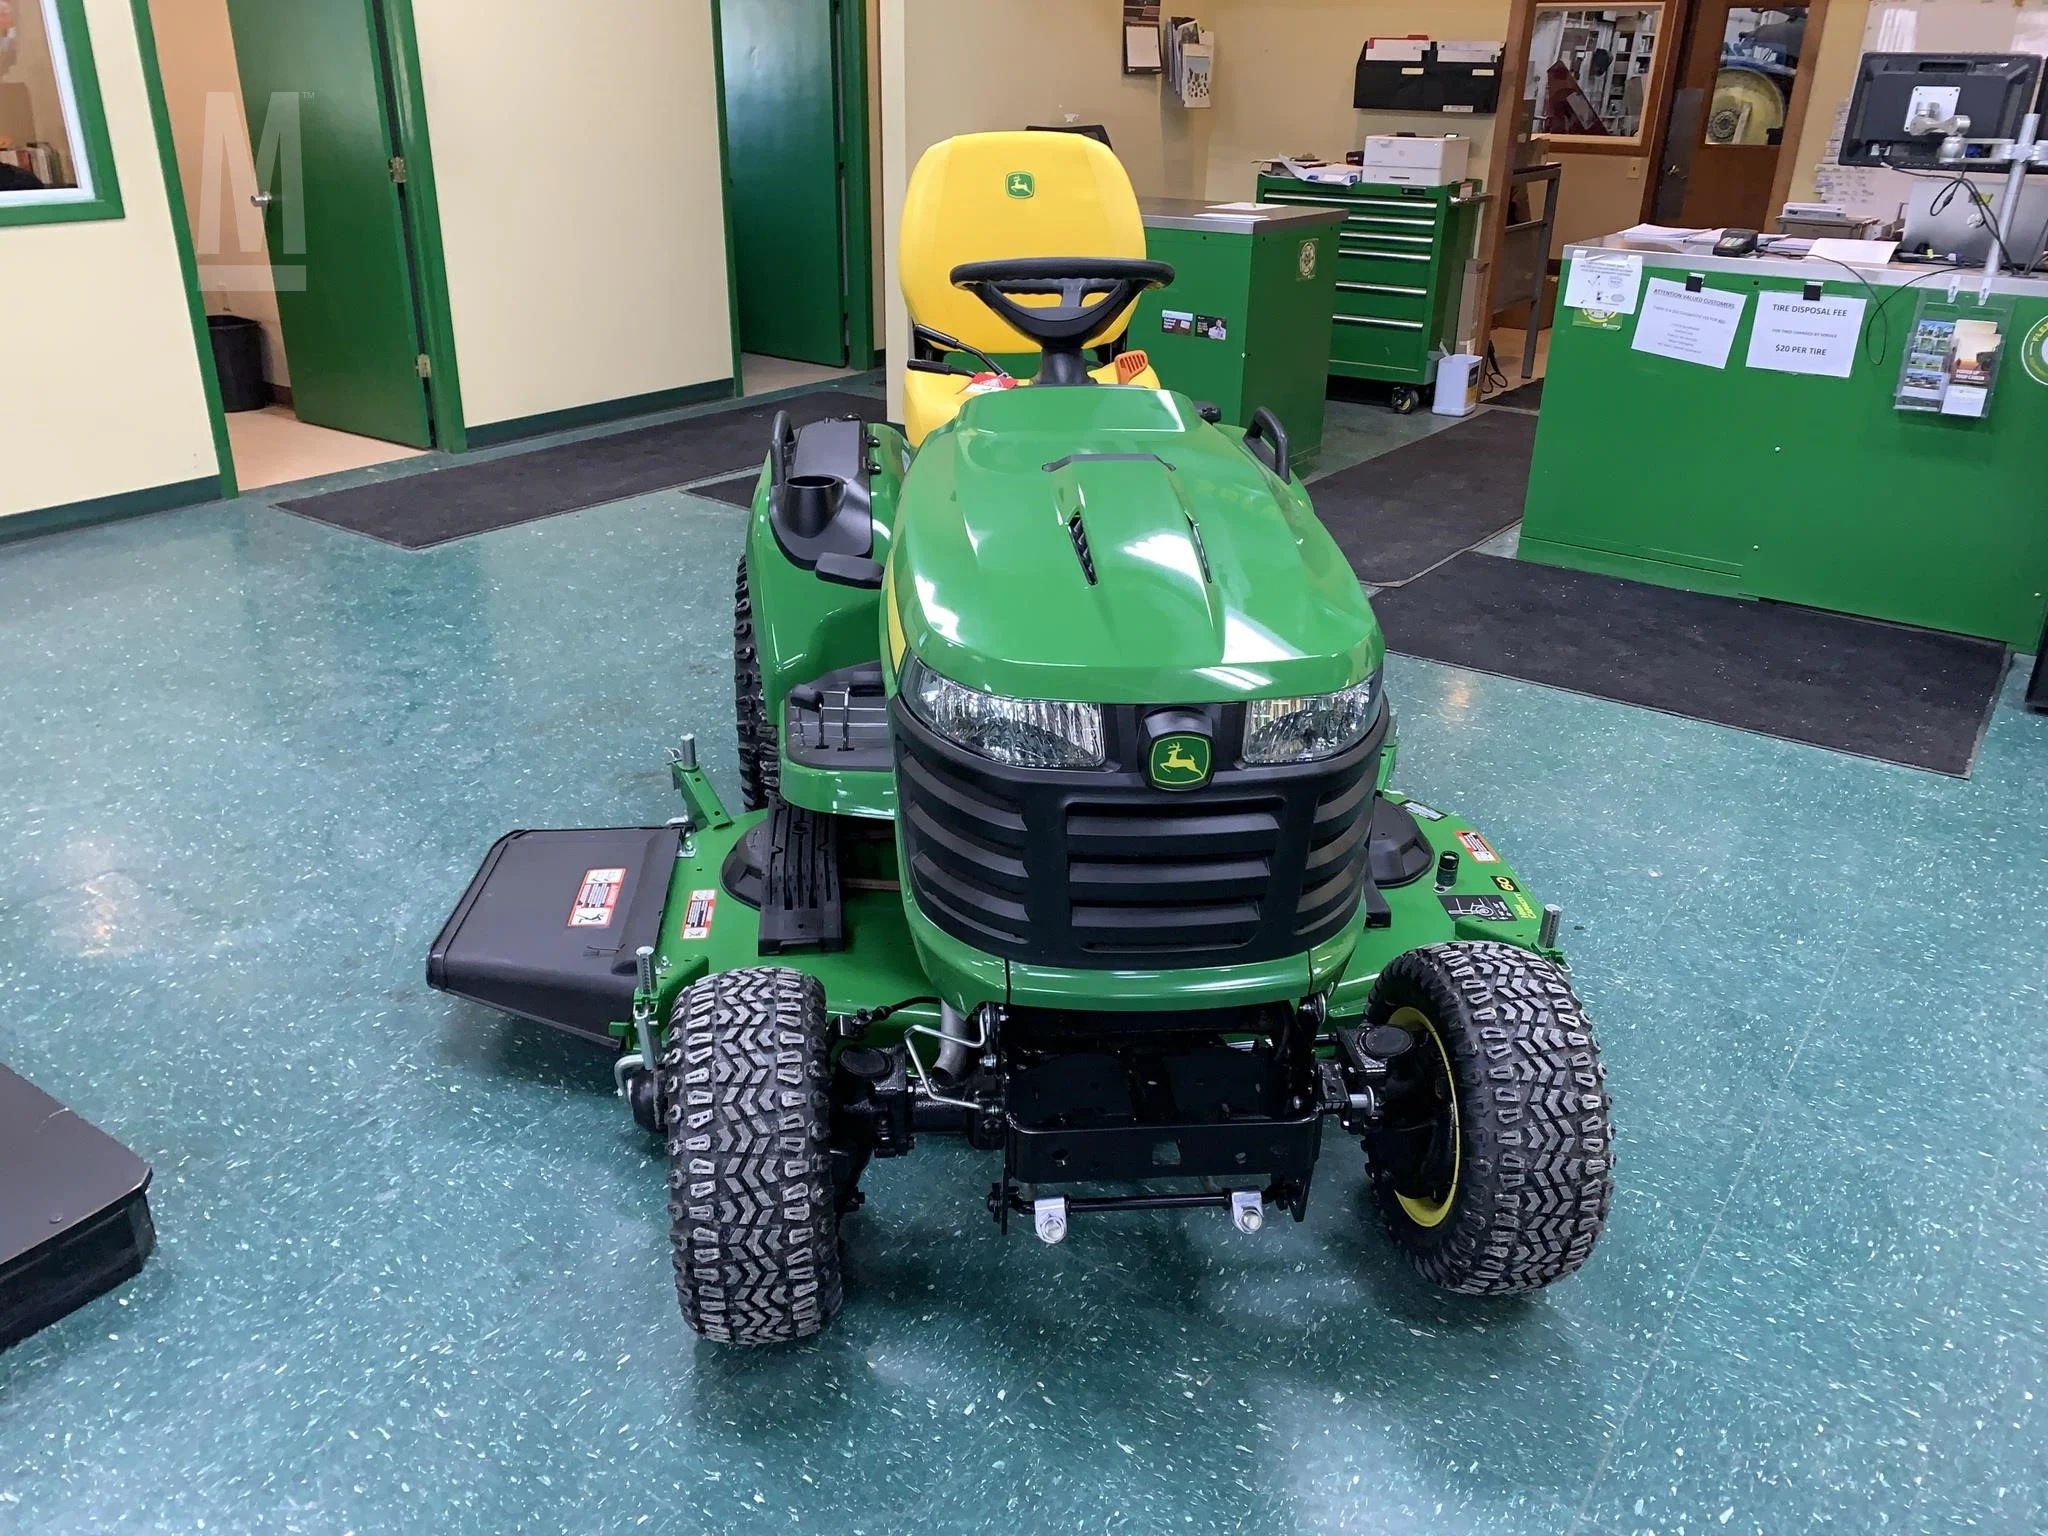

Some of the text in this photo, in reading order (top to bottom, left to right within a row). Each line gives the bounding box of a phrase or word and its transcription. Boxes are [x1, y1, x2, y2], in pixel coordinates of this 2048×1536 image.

[1653, 288, 1735, 310] ATTENTION VALUED CUSTOMERS
[1773, 303, 1847, 317] TIRE DISPOSAL FEE
[1775, 344, 1827, 356] $20 PER TIRE
